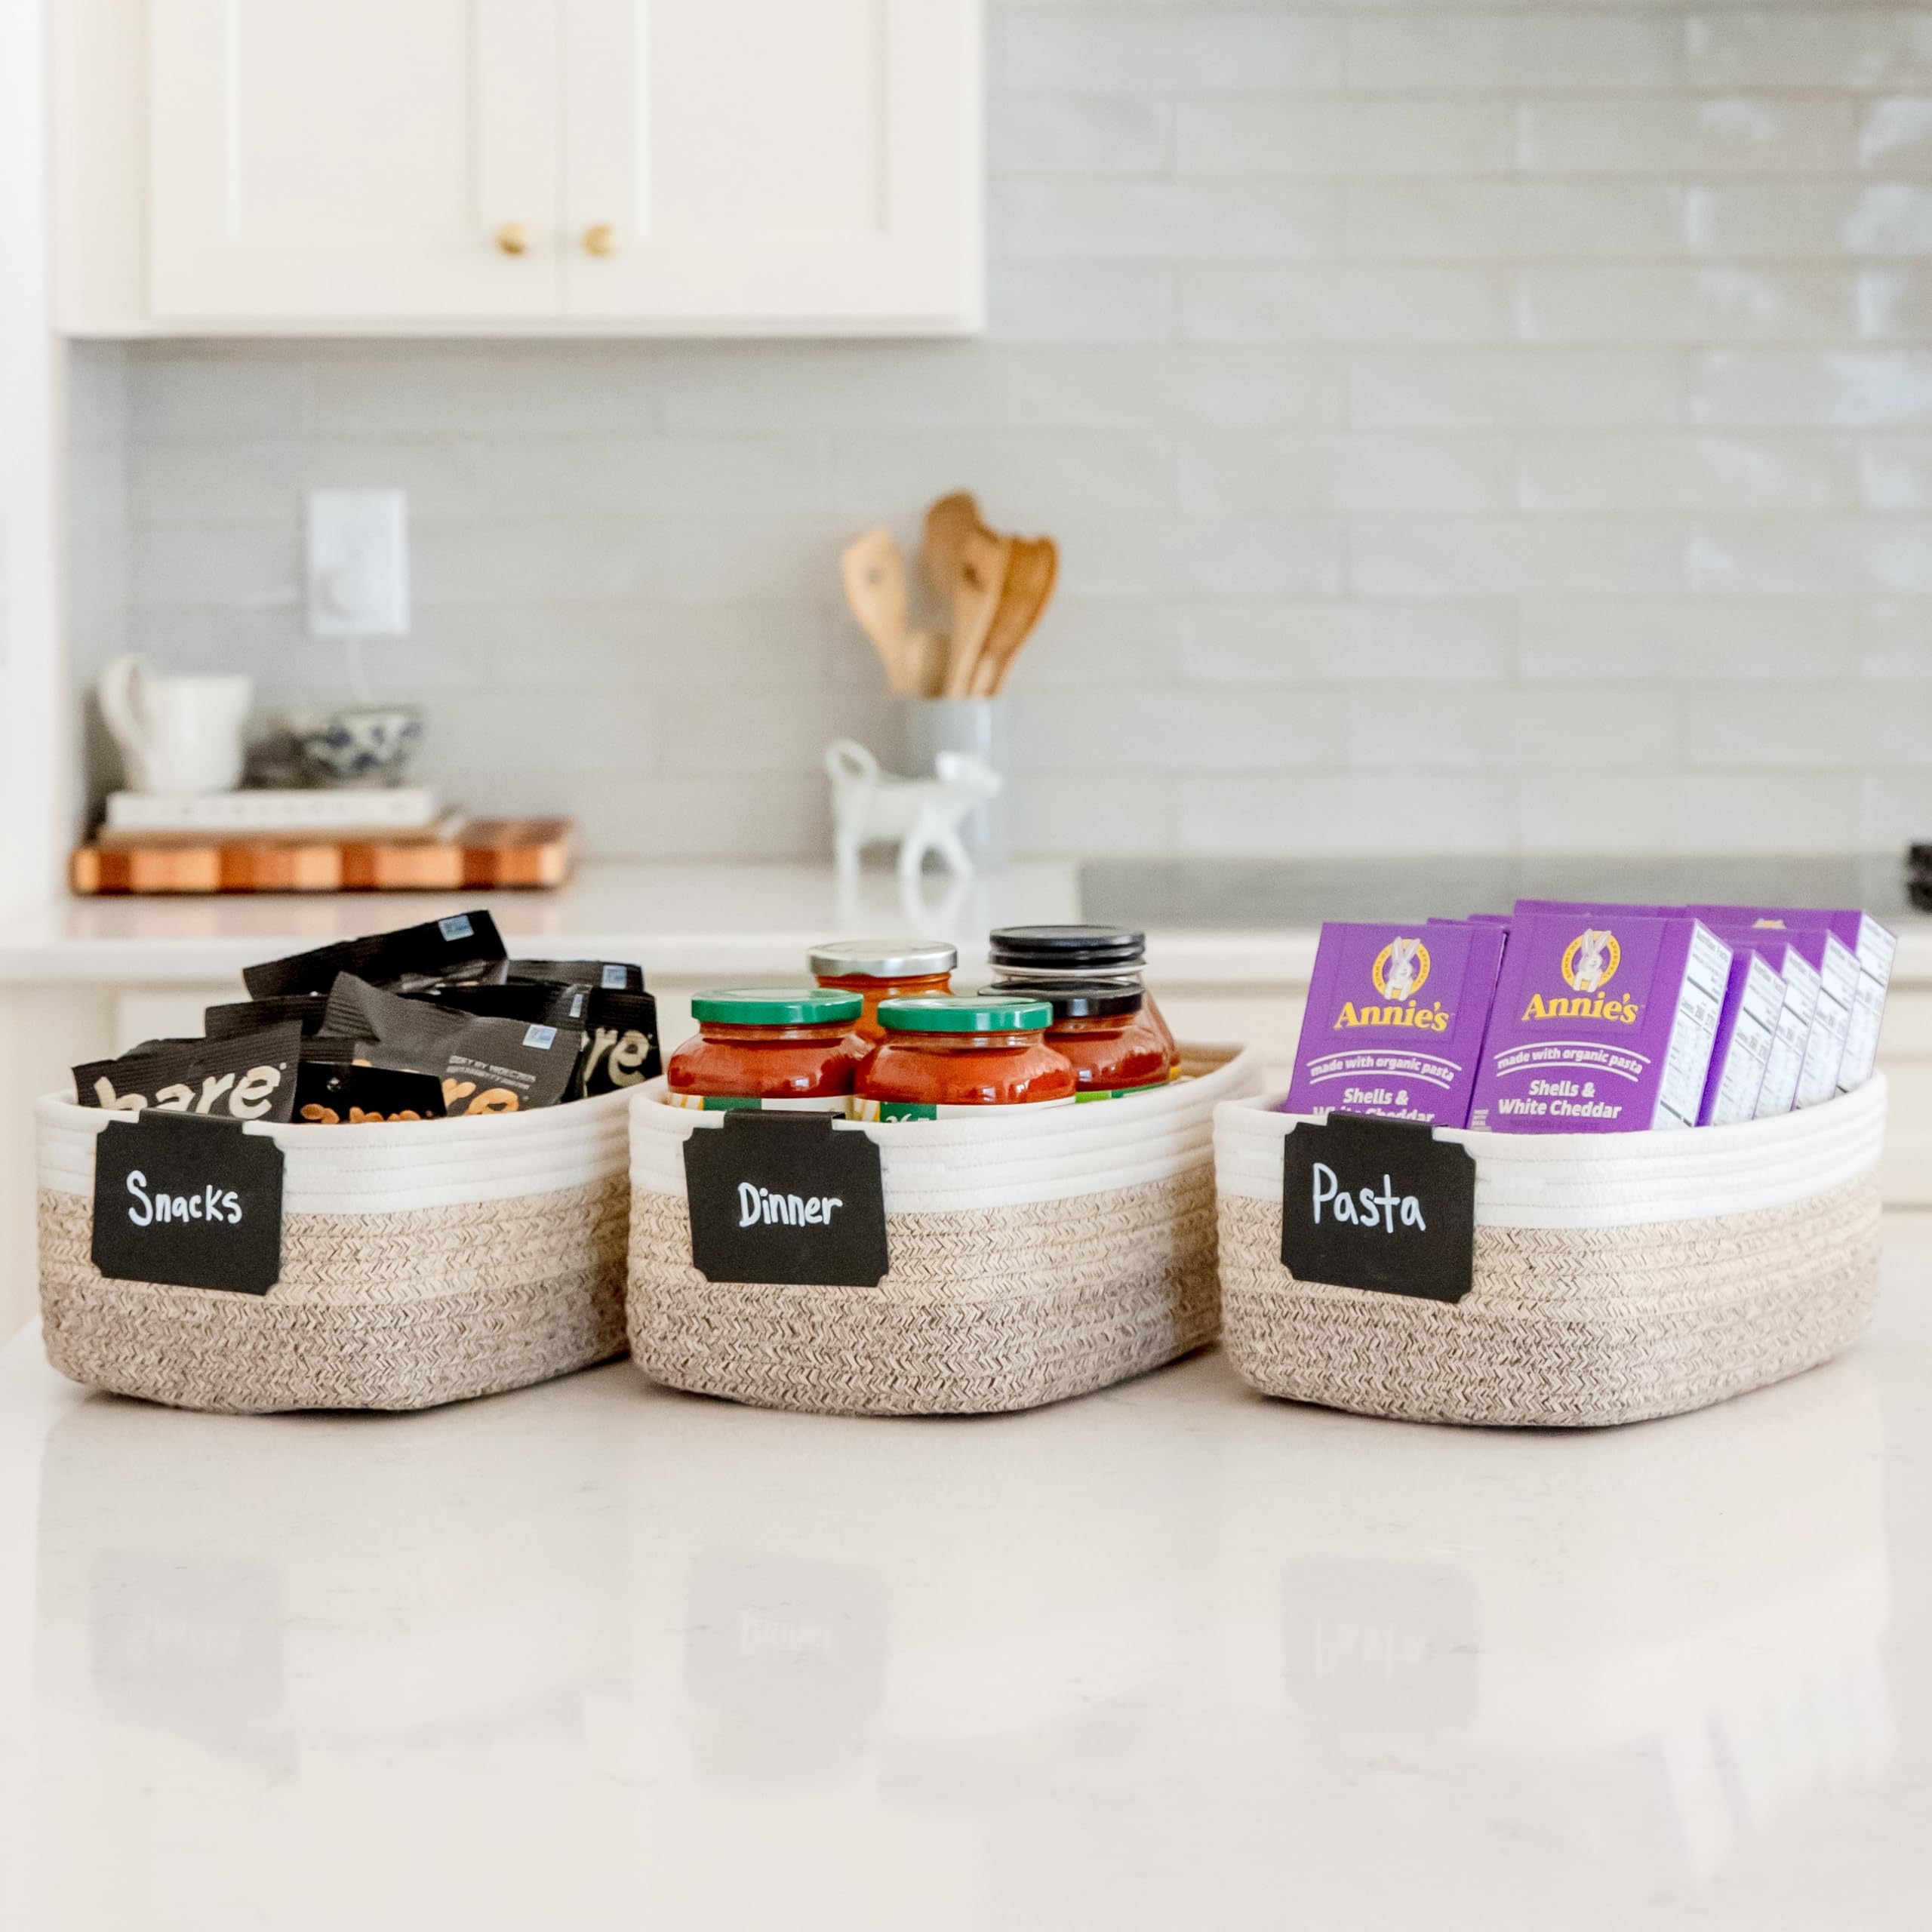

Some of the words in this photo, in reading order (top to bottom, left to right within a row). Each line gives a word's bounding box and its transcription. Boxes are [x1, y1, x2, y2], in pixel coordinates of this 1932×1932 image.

[1333, 1000, 1450, 1032] Annie's
[1521, 991, 1639, 1024] Annie's
[580, 1027, 649, 1088] re
[1311, 1060, 1344, 1077] made
[1345, 1056, 1374, 1069] with
[1376, 1057, 1422, 1071] organic
[1420, 1063, 1455, 1081] pasta
[1497, 1052, 1531, 1069] made
[1532, 1048, 1561, 1060] with
[1562, 1049, 1610, 1062] organic
[1608, 1055, 1643, 1075] pasta
[1343, 1088, 1394, 1105] Shells
[1395, 1090, 1409, 1106] &
[1528, 1079, 1580, 1097] Shells
[1582, 1081, 1596, 1097] &
[1498, 1098, 1547, 1115] White
[1549, 1100, 1623, 1119] Cheddar
[126, 1170, 243, 1226] Snacks
[737, 1182, 844, 1227] Dinner
[1312, 1162, 1426, 1234] Pasta
